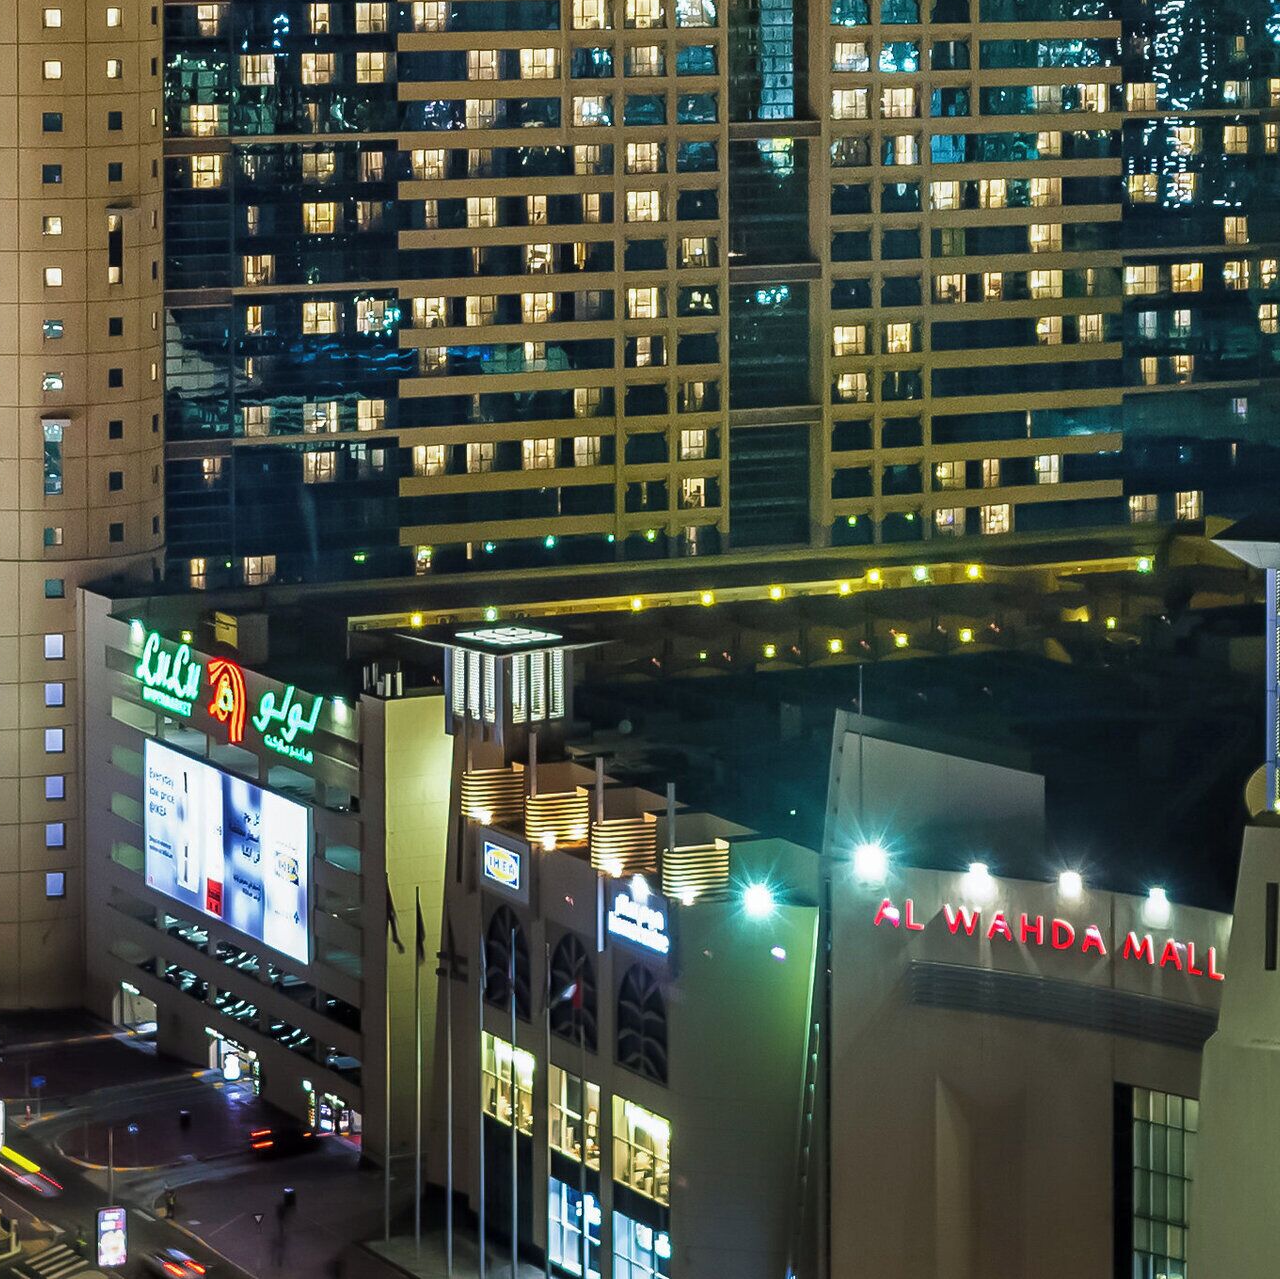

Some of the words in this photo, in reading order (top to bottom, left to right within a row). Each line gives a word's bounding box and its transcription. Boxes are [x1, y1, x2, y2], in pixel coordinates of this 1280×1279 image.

[252, 685, 324, 743] لولو
[874, 898, 924, 930] AL
[943, 903, 1108, 955] WAHDA
[1123, 931, 1225, 981] MALL
